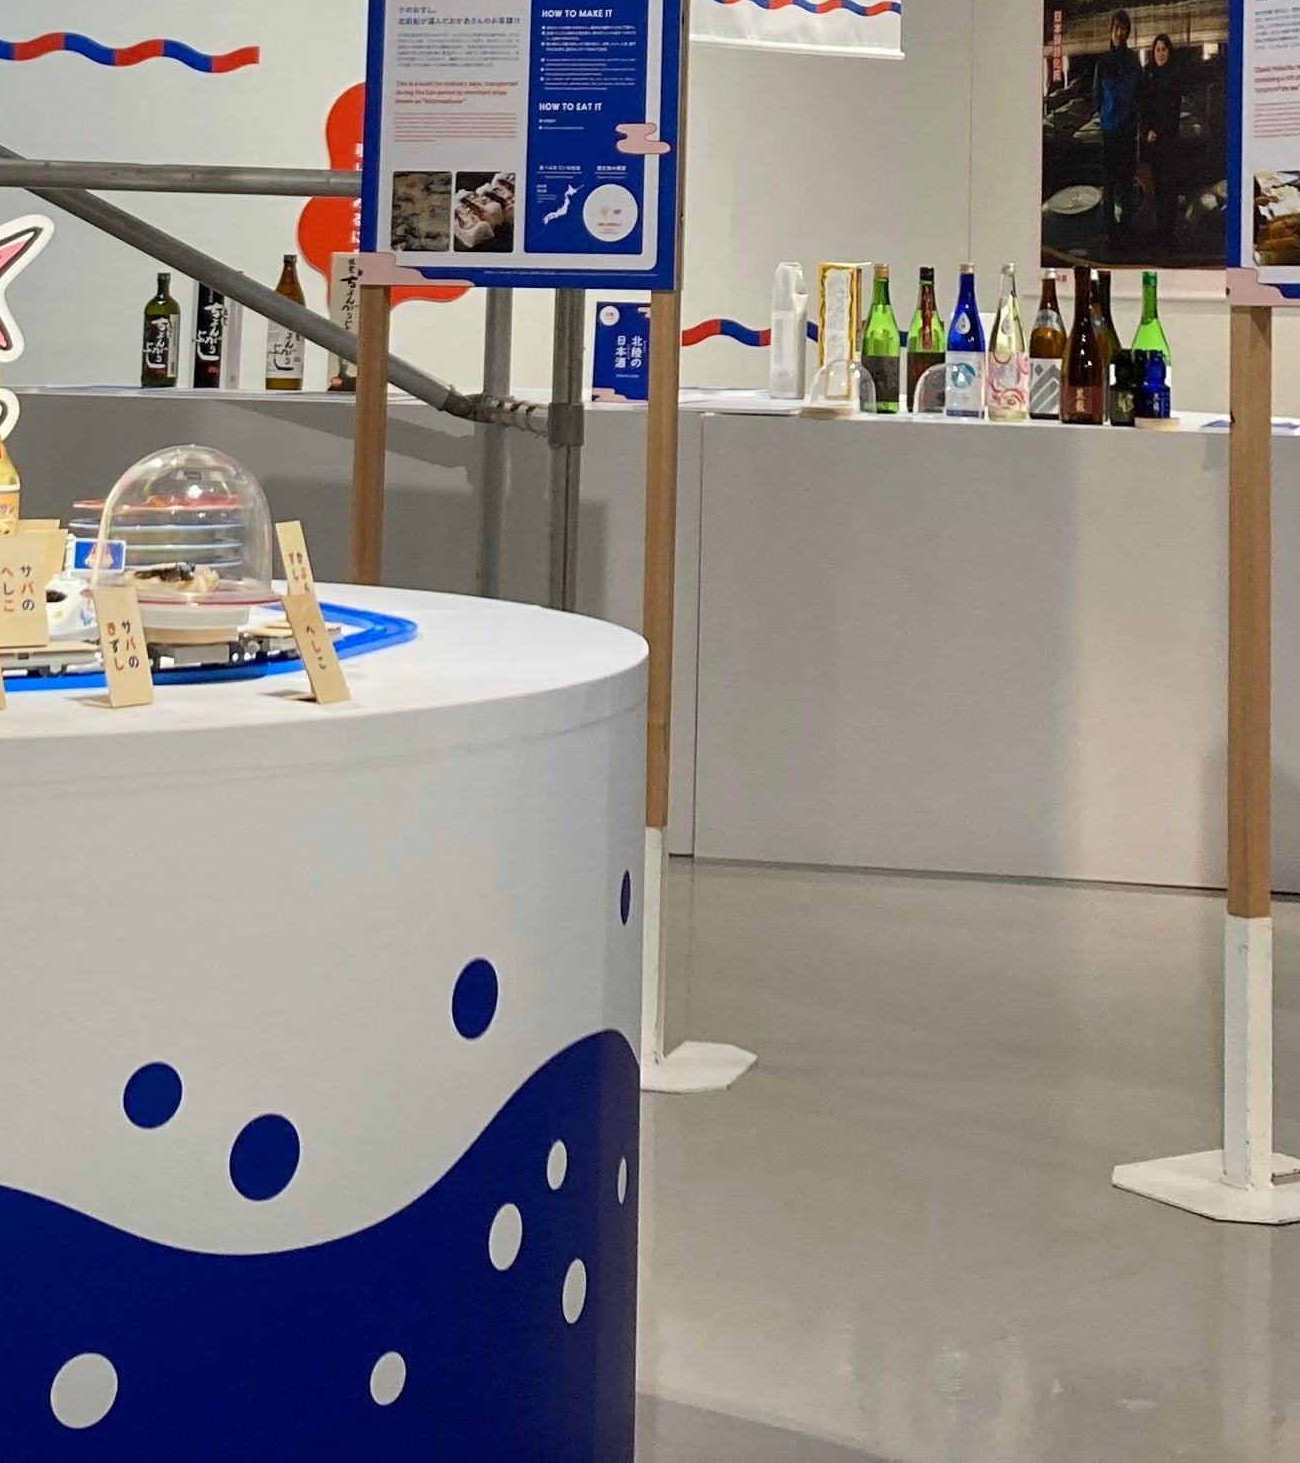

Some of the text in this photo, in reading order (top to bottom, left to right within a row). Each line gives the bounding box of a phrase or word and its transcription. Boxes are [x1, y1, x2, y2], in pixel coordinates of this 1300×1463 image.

[541, 10, 563, 18] HOW
[579, 9, 604, 17] MAKE
[605, 9, 613, 17] IT
[539, 103, 560, 111] HOW
[594, 102, 602, 110] IT
[614, 335, 627, 369] 日本酒
[631, 335, 643, 369] 北陸の
[0, 565, 15, 613] へしこ
[19, 564, 36, 612] サバの
[120, 619, 140, 669] サバの
[305, 624, 328, 671] へしこ
